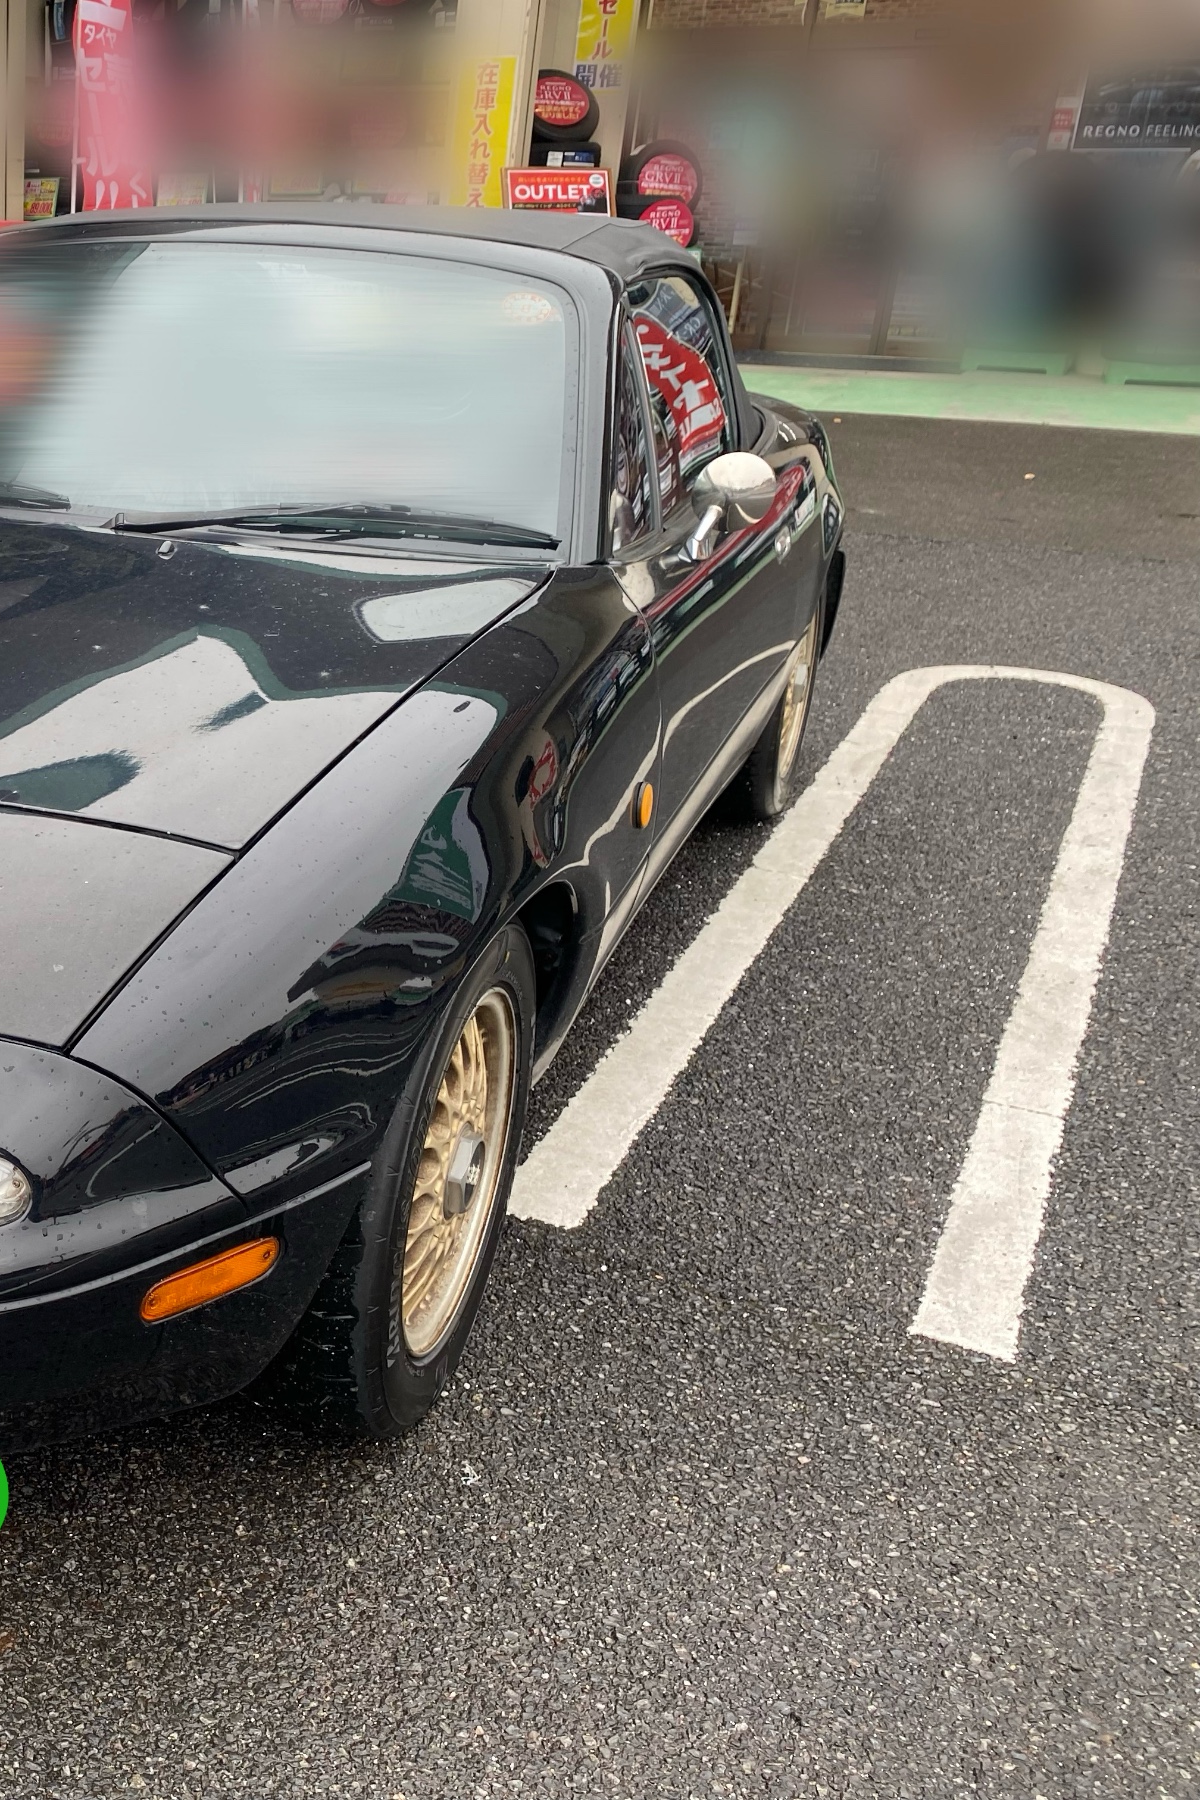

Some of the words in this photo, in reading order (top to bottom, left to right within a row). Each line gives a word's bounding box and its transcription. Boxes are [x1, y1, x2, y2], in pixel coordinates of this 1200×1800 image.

[84, 24, 117, 49] タイヤ
[575, 63, 622, 88] 開催
[466, 62, 499, 208] 在庫入れ替え
[1083, 124, 1141, 138] REGNO
[653, 164, 684, 173] REGNO
[514, 184, 590, 200] OUTLET
[650, 209, 681, 219] REGNO
